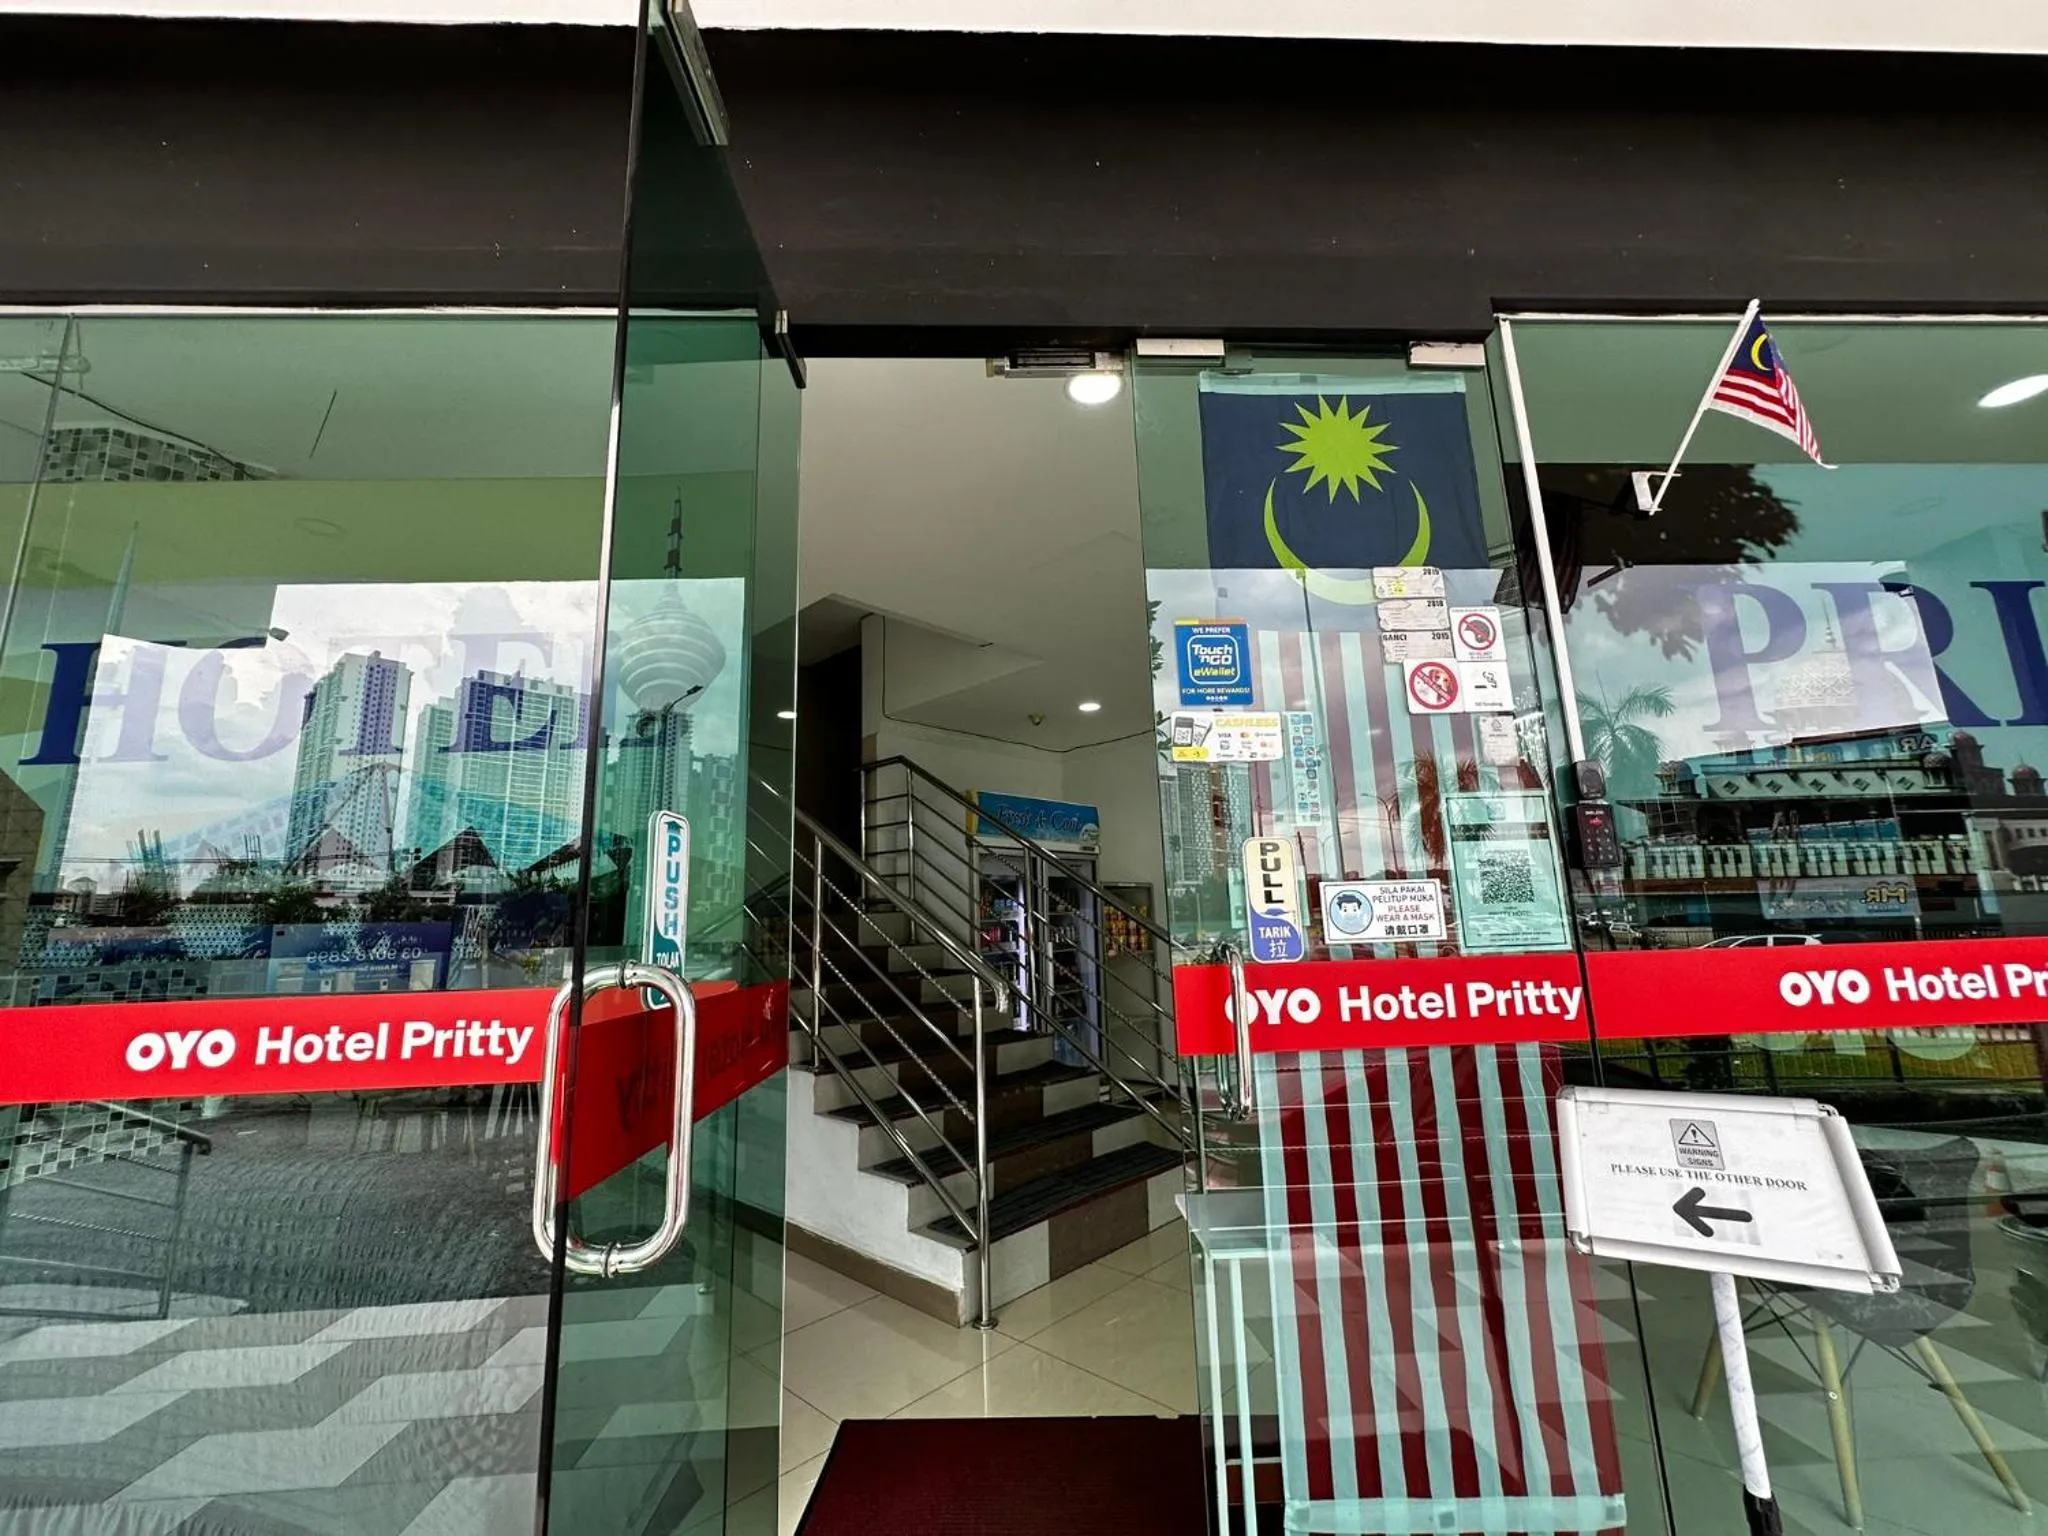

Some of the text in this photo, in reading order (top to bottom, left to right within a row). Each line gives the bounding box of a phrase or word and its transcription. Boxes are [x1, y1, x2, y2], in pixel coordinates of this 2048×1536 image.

[1192, 644, 1233, 655] Touch
[1193, 667, 1236, 677] eWallet
[1259, 842, 1285, 905] PULL
[664, 834, 681, 936] PUSH
[1379, 885, 1425, 895] SILA PAKAI
[1371, 893, 1435, 904] PELITUP MUKA
[1387, 904, 1421, 913] PLEASE
[1375, 912, 1436, 923] WEAR A MASK
[1258, 926, 1292, 939] TARIK
[1269, 941, 1289, 959] 拉
[656, 952, 680, 967] TOLAK
[1778, 962, 2048, 1007] OYO Hotel Pr
[1224, 980, 1583, 1025] OYO Hotel Pritty
[125, 1018, 534, 1073] OYO Hotel Pritty
[1678, 1146, 1720, 1158] WARNING
[1687, 1157, 1715, 1168] SIGNS
[1610, 1163, 1809, 1192] PLEASE USE THE OTHER DOOR
